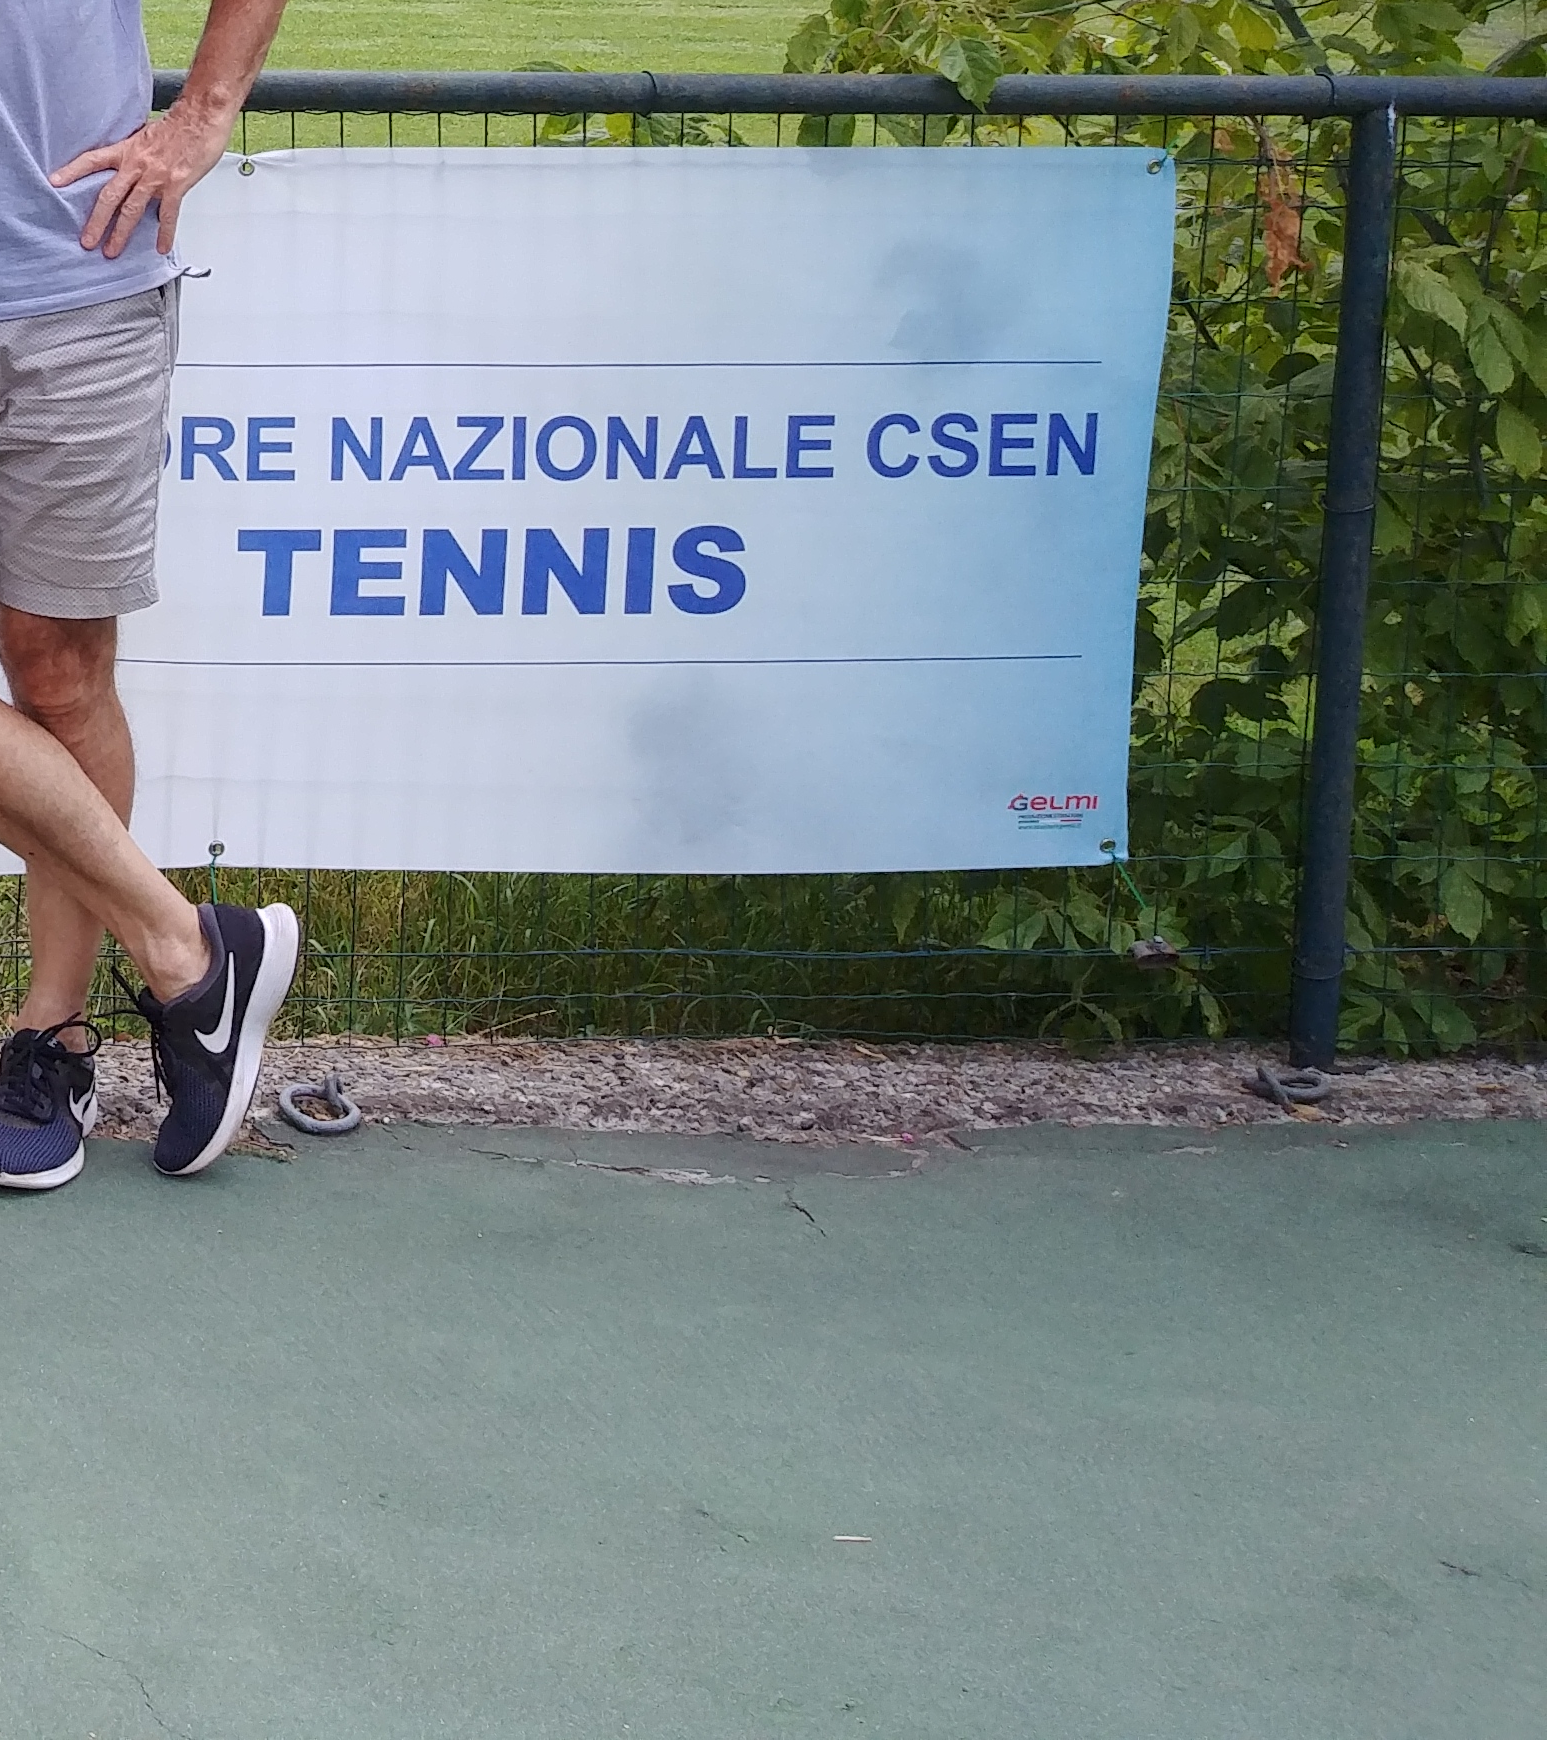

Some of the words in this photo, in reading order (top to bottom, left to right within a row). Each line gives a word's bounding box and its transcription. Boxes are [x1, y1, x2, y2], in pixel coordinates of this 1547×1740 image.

[164, 415, 296, 481] RE
[330, 414, 835, 481] NAZIONALE
[866, 411, 1100, 479] CSEN
[237, 525, 747, 616] TENNIS
